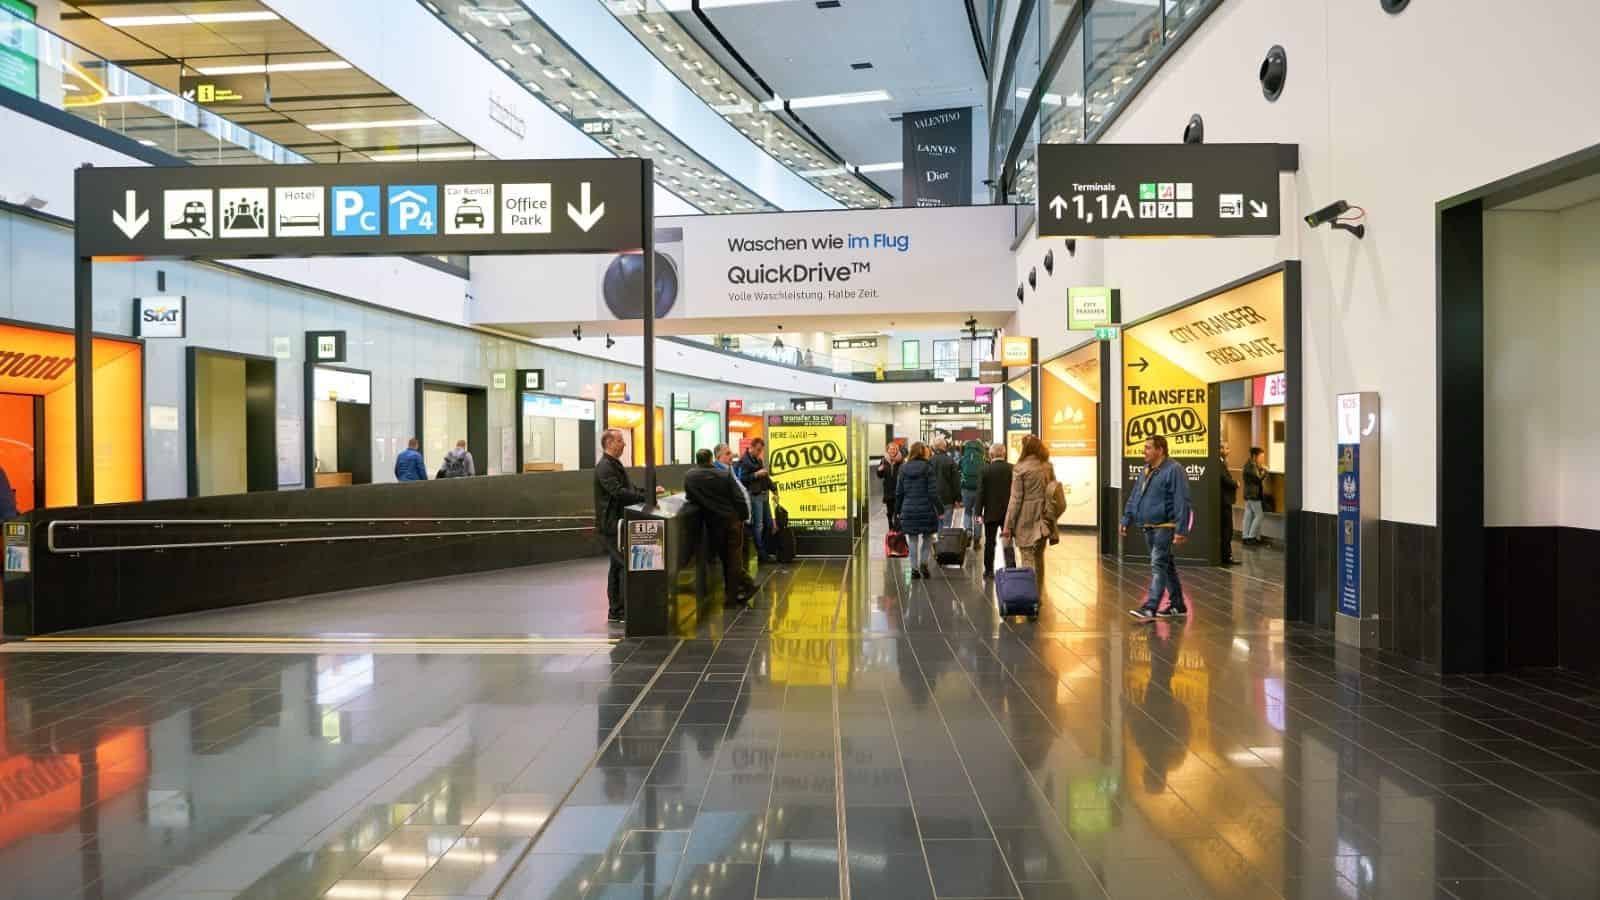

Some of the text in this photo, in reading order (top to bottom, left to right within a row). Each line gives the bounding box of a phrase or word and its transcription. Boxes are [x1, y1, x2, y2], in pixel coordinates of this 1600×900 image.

[914, 112, 961, 129] VALENTINO
[917, 144, 957, 153] LANVIN
[926, 170, 950, 182] Dior
[463, 187, 492, 195] Rental
[1072, 183, 1116, 191] Terminals
[284, 191, 315, 200] Hotel
[505, 198, 548, 212] Office
[1072, 194, 1135, 223] 1,1A
[399, 201, 433, 231] P4
[511, 214, 542, 226] Park
[728, 234, 909, 252] Waschen wie im Flug
[728, 292, 751, 301] Volle
[828, 289, 856, 299] Halbe
[858, 289, 880, 298] Zeit.
[1169, 305, 1268, 344] CITY TRANSFER
[1238, 337, 1284, 359] RATE
[1131, 410, 1196, 440] 40100
[774, 443, 837, 470] 40100
[1185, 464, 1206, 476] city
